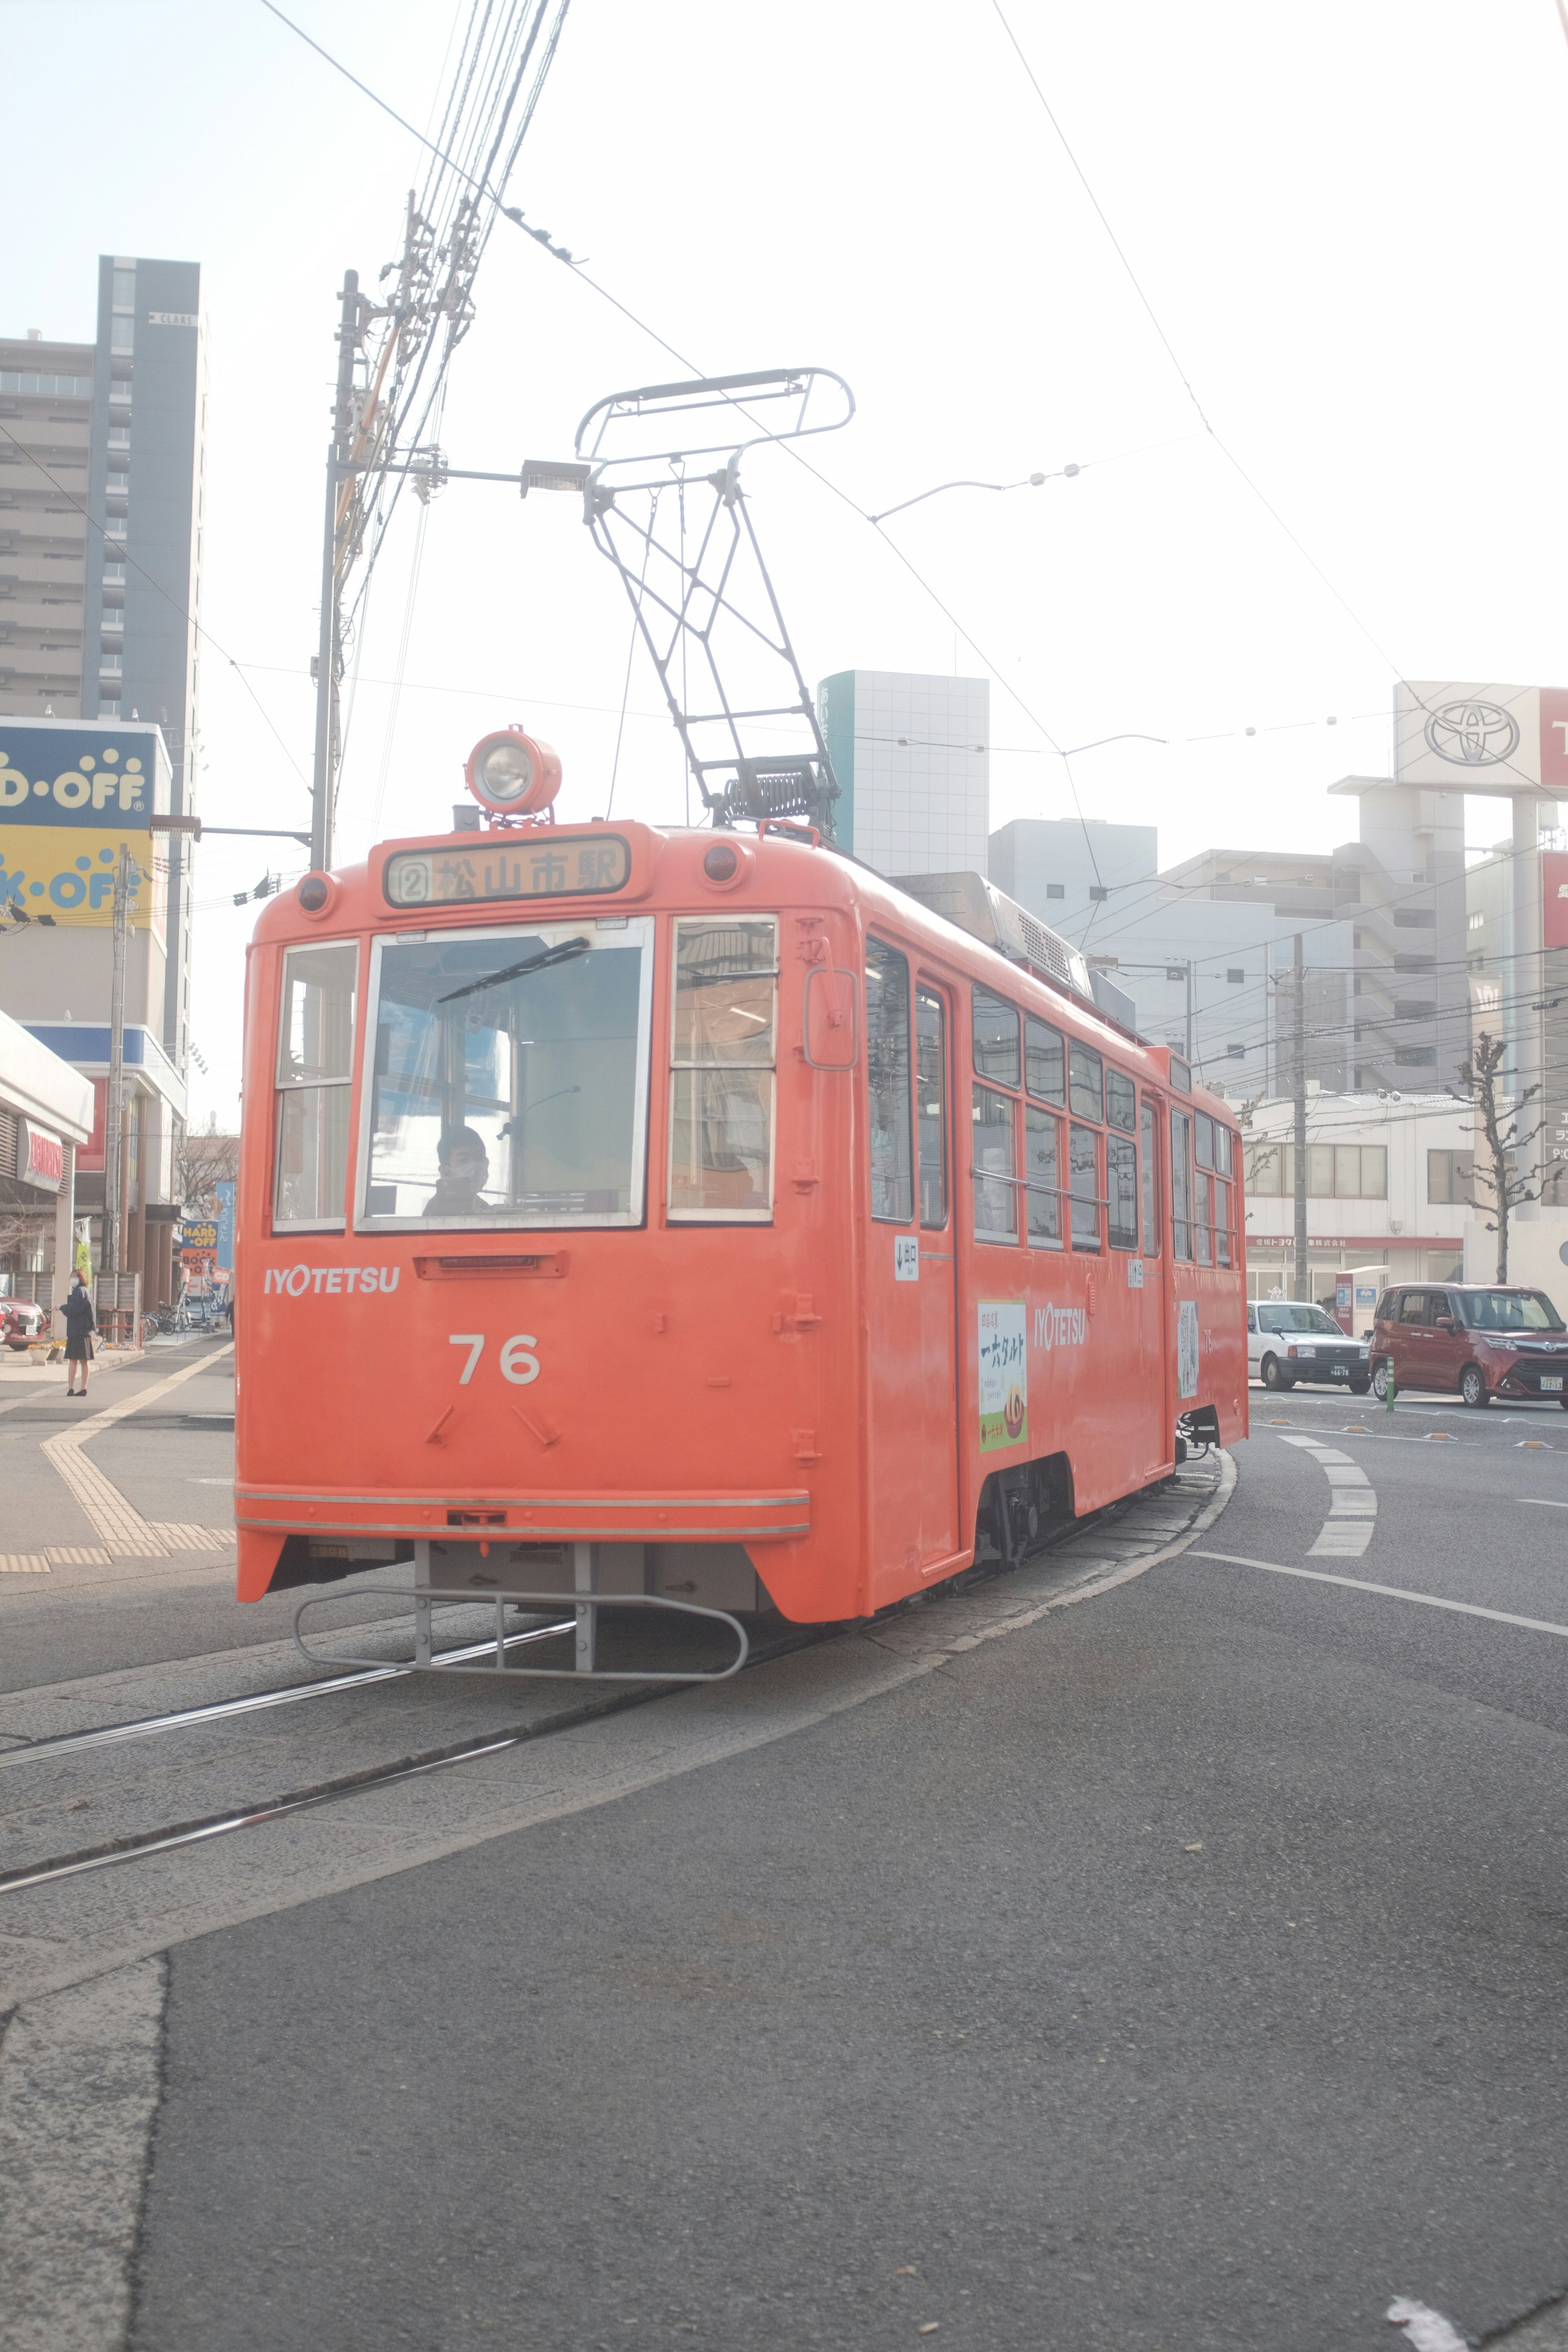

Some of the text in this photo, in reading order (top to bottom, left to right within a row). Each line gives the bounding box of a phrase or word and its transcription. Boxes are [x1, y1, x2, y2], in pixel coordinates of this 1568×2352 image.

[437, 848, 618, 899] 松山市駅
[184, 1227, 216, 1237] HARD
[1256, 1238, 1346, 1247] 愛媛トヨタ車株式会社
[904, 1243, 916, 1263] 出口
[213, 1271, 230, 1281] CD
[264, 1264, 400, 1296] IYOTETSU
[1034, 1302, 1086, 1351] IYOTETSU
[981, 1333, 1024, 1368] 一六タルト
[1204, 1329, 1212, 1355] 76
[449, 1334, 541, 1385] 76
